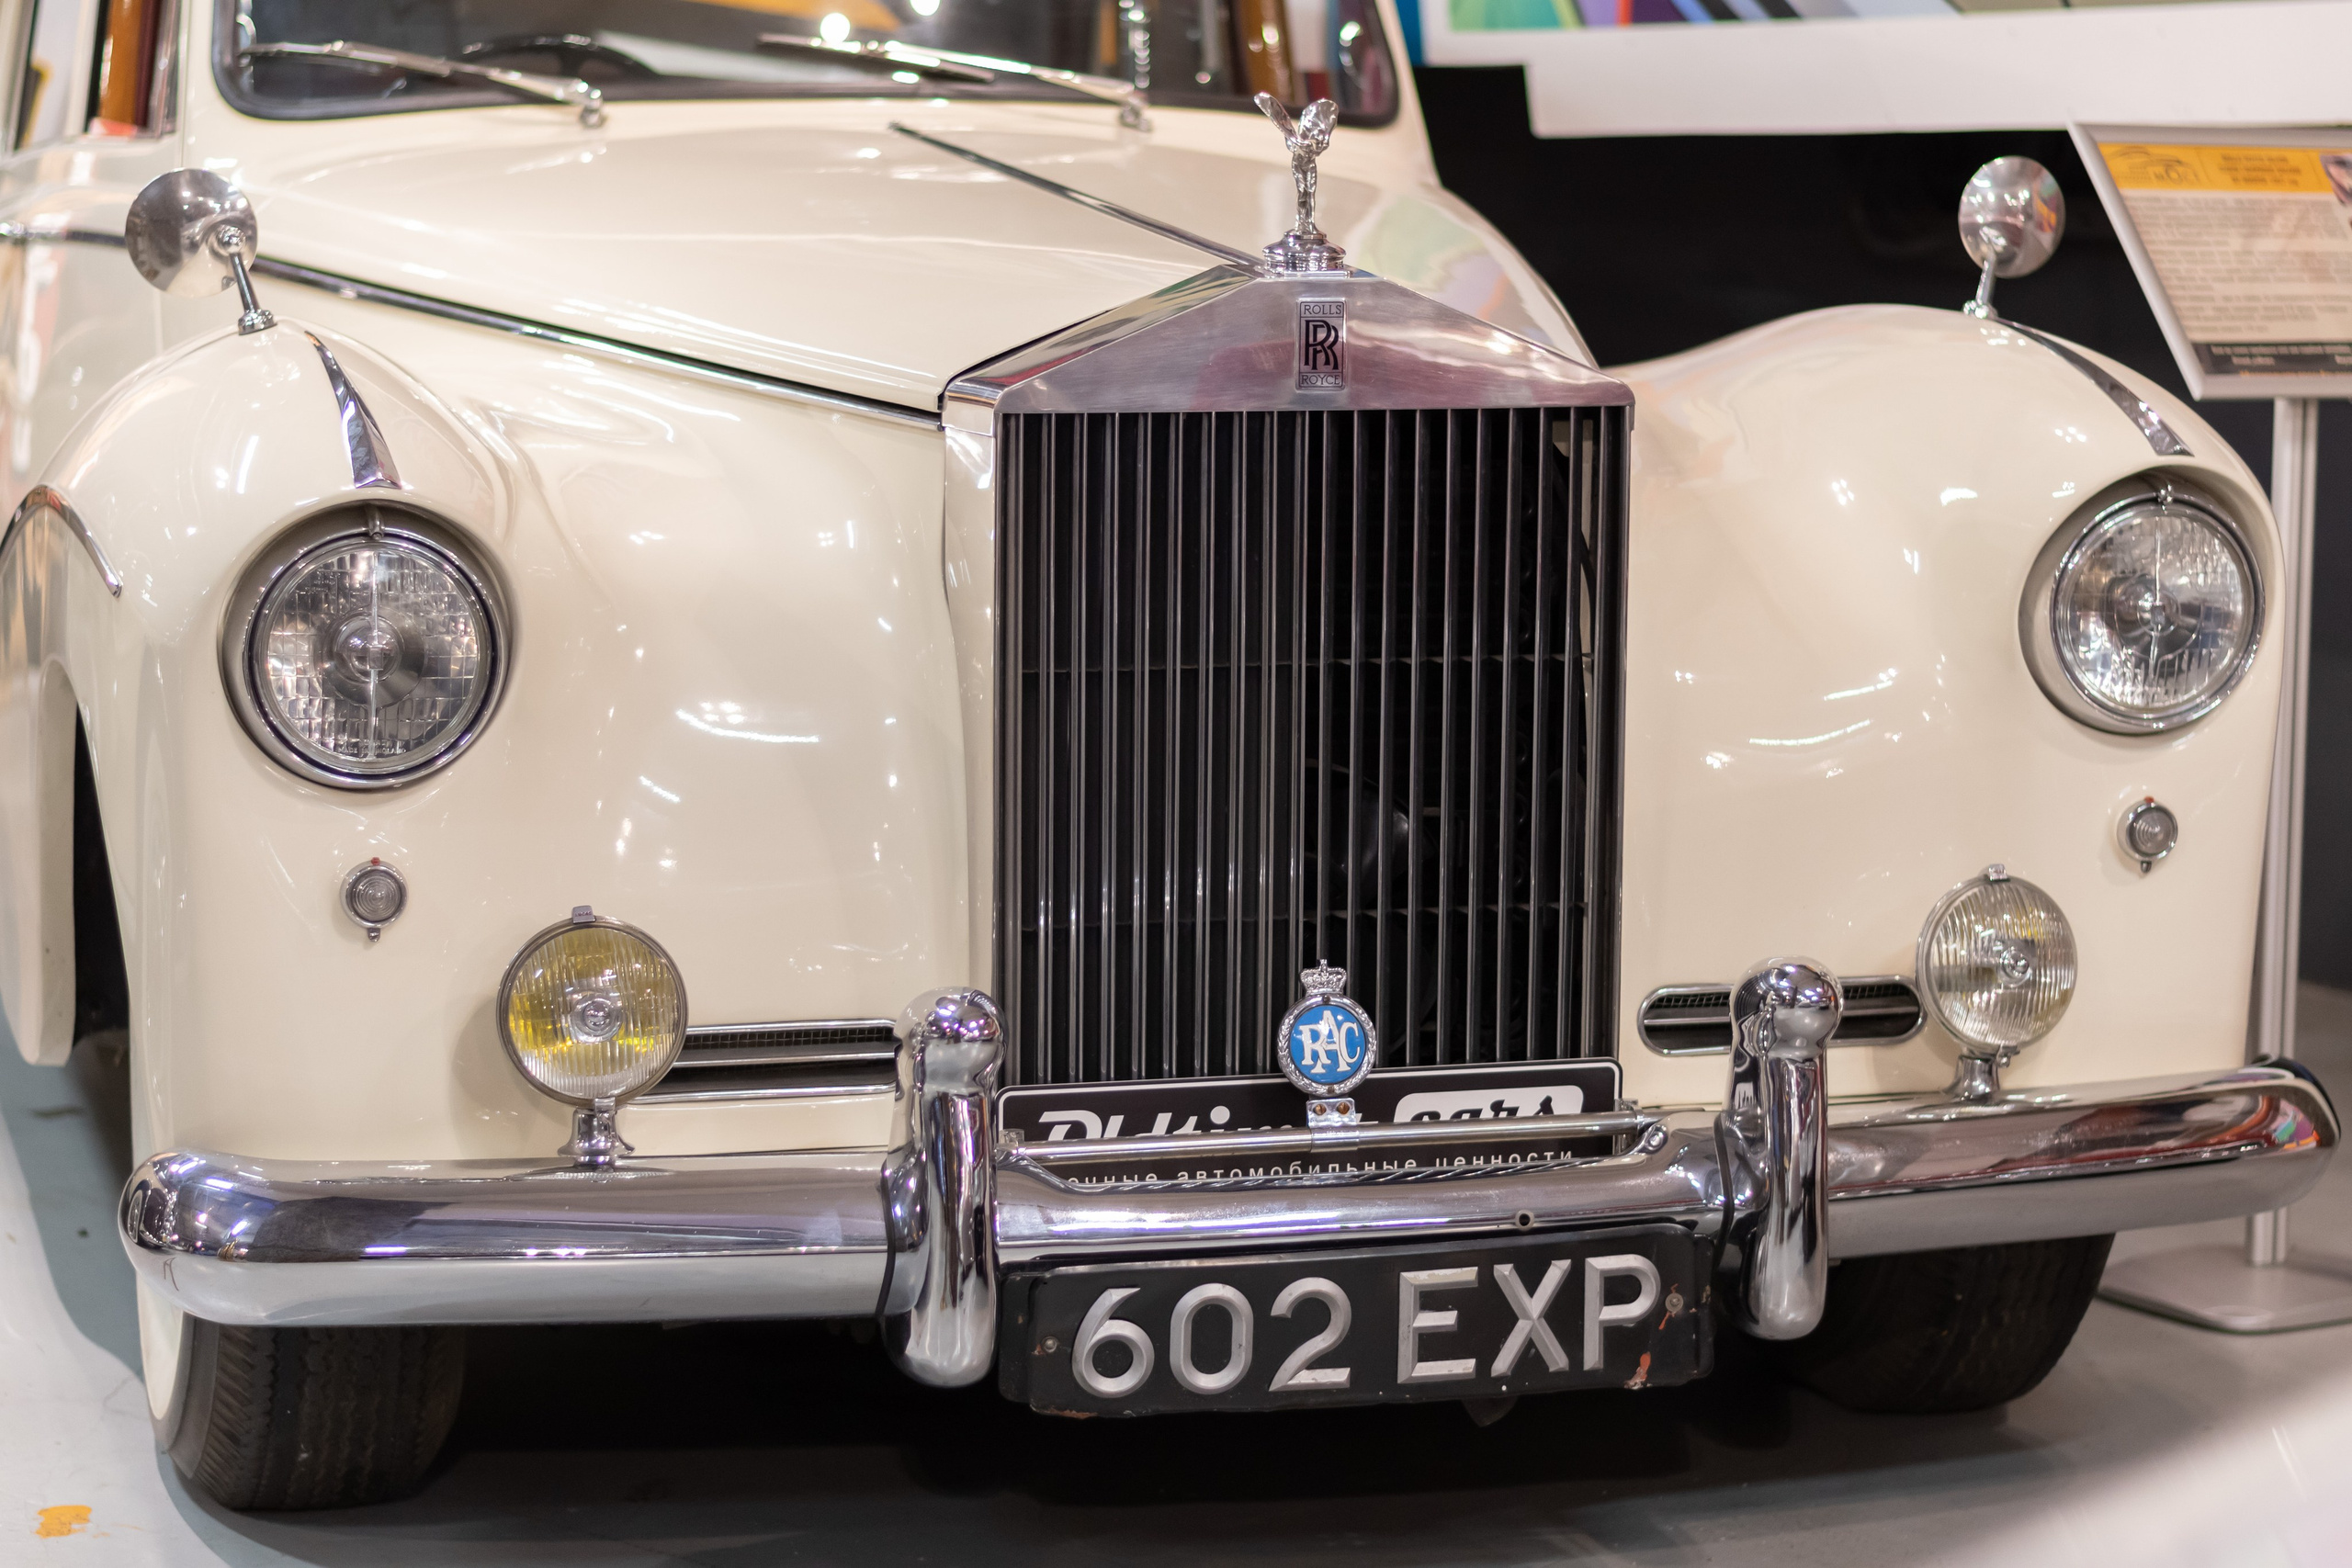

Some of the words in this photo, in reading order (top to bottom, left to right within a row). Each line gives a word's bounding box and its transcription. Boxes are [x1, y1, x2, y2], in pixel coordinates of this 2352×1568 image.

[1304, 304, 1341, 315] ROLLS
[1301, 375, 1340, 385] ROYCE
[1299, 1010, 1360, 1073] RAC
[1435, 1151, 1572, 1168] ценности
[1072, 1277, 1351, 1398] 602
[1398, 1254, 1661, 1384] EXP
